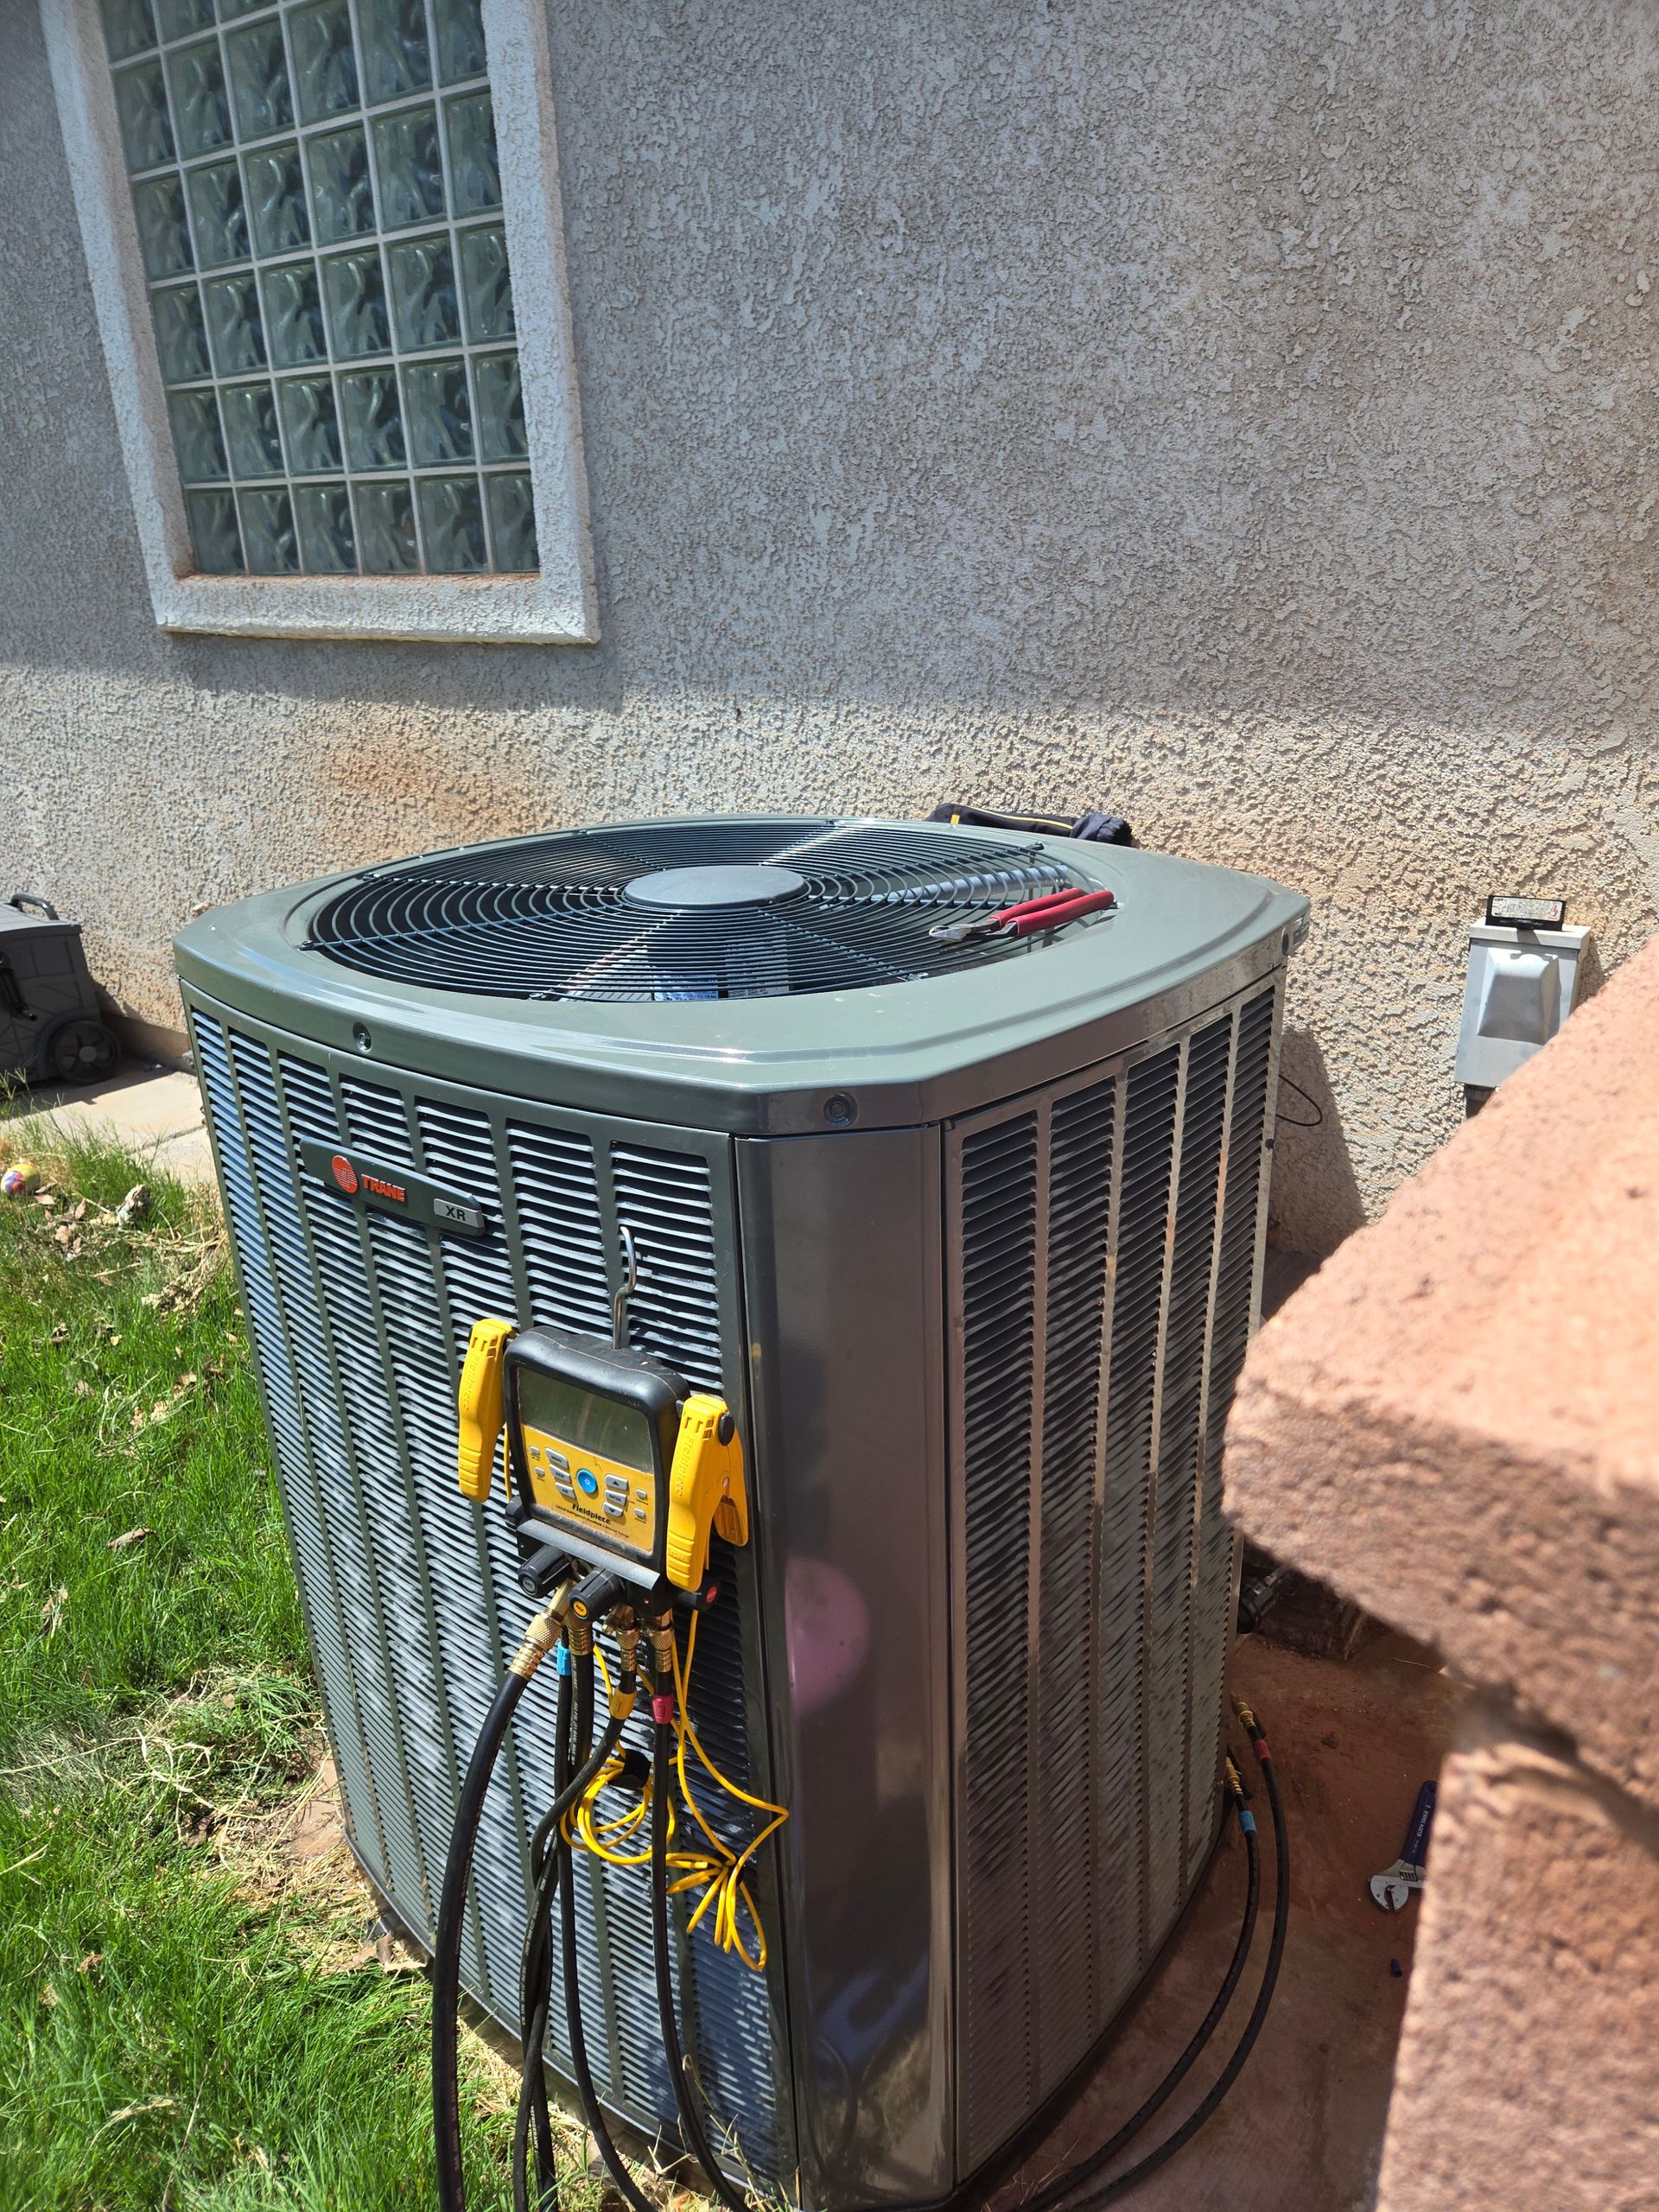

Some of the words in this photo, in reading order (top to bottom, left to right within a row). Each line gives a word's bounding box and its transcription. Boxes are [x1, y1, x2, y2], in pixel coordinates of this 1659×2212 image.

[361, 1173, 406, 1203] TRANE
[445, 1205, 467, 1222] XR
[572, 1503, 611, 1524] Fieldpiece
